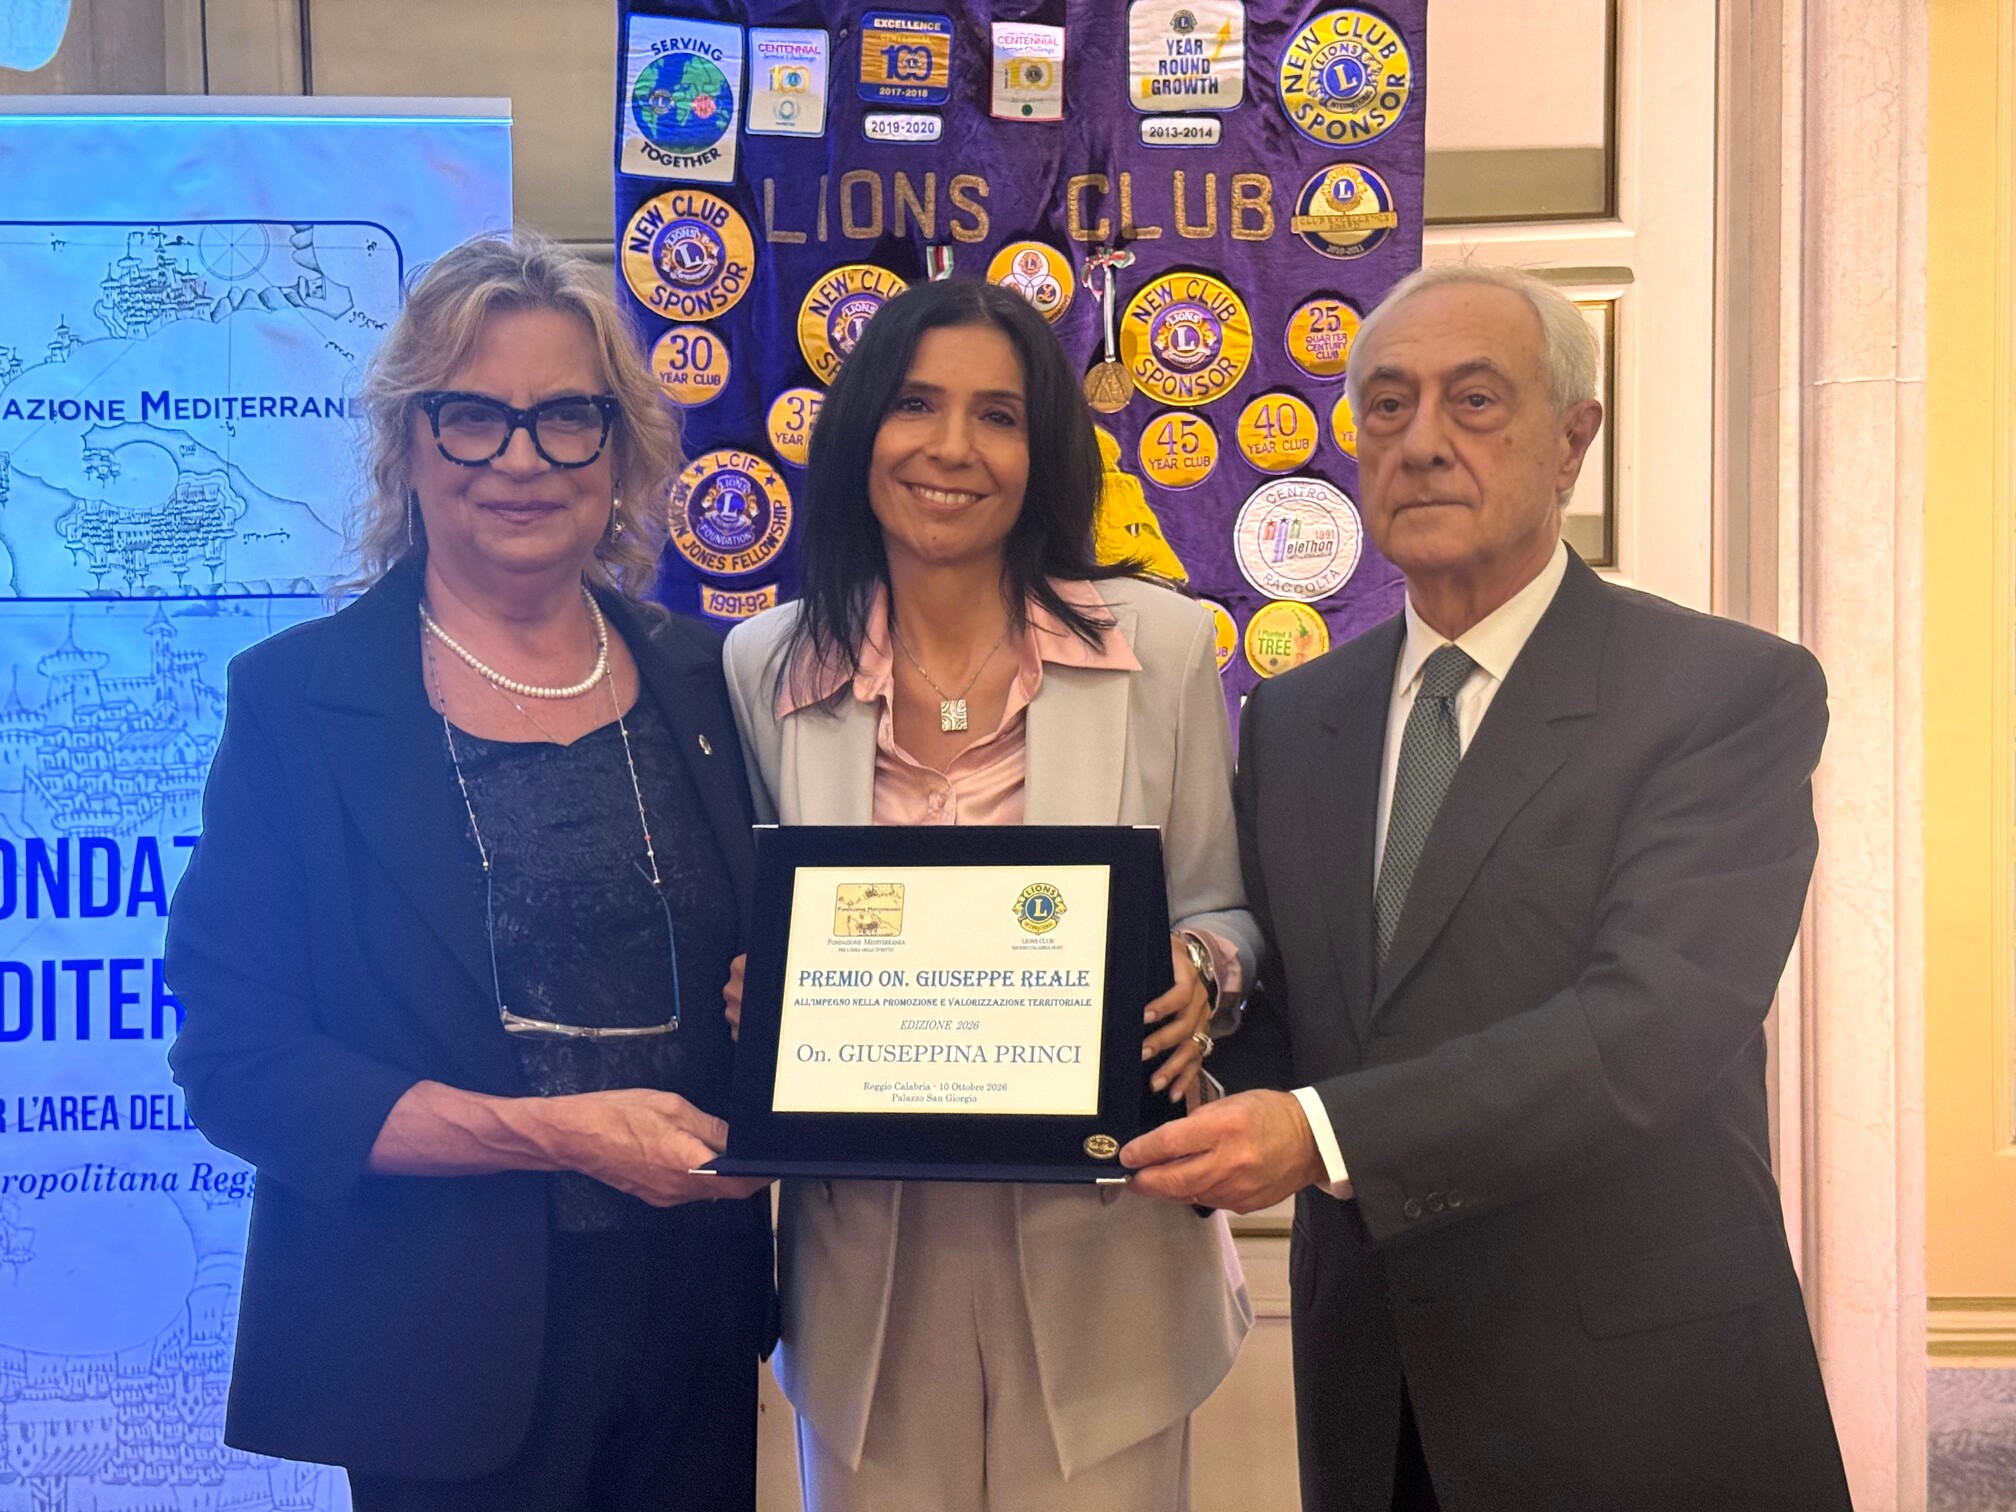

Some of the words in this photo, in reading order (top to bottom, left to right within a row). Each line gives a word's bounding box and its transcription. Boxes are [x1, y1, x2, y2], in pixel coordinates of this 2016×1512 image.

[874, 18, 941, 31] EXCELLENCE
[651, 37, 723, 61] SERVING
[758, 44, 821, 54] CENTENNIAL
[997, 36, 1059, 46] CENTENNIAL
[1166, 38, 1203, 56] YEAR
[880, 45, 933, 81] 100
[1284, 27, 1321, 94] NEW
[1332, 16, 1398, 59] CLUB
[1316, 43, 1359, 65] LIONS
[1158, 58, 1210, 76] ROUND
[1151, 77, 1218, 95] GROWTH
[1333, 64, 1358, 91] L
[879, 87, 928, 97] 2017-2018
[1294, 74, 1406, 140] SPONSOR
[871, 121, 934, 133] 2019-2020
[1149, 127, 1212, 138] 2013-2014
[640, 141, 722, 168] TOGETHER
[763, 170, 990, 244] LIONS
[1067, 170, 1276, 242] CLUB
[629, 205, 665, 254] NEW
[672, 195, 730, 228] CLUB
[669, 228, 697, 246] LIONS
[677, 244, 702, 268] L
[649, 262, 747, 316] SPONSOR
[809, 273, 850, 318] NEW
[861, 270, 902, 300] CLU
[1132, 281, 1174, 324] NEW
[1186, 280, 1237, 323] CLUB
[1167, 312, 1200, 325] LIONS
[1309, 306, 1342, 332] 25
[1176, 327, 1195, 351] L
[1306, 333, 1347, 344] QUARTER
[1306, 342, 1346, 352] CENTURY
[669, 334, 712, 371] 30
[1316, 351, 1339, 360] CLUB
[660, 372, 688, 384] YEAR
[693, 374, 721, 386] CLUB
[1135, 356, 1238, 397] SPONSOR
[2, 398, 125, 421] AZIONE
[1254, 403, 1297, 439] 40
[775, 432, 804, 446] YEAR
[1157, 420, 1199, 455] 45
[1340, 431, 1354, 442] YE
[1246, 442, 1277, 455] YEAR
[1282, 439, 1310, 451] CLUB
[715, 453, 759, 470] LCIF
[1148, 458, 1177, 471] YEAR
[1184, 456, 1211, 467] CLUB
[718, 479, 750, 494] LIONS
[1266, 486, 1327, 505] CENTRO
[721, 492, 738, 517] L
[682, 540, 726, 571] JONES
[732, 499, 787, 571] FELLOWSHIP
[700, 526, 751, 545] FOUNDATION
[1315, 530, 1335, 540] 1991
[1263, 569, 1341, 594] RACCOLTA
[709, 592, 770, 614] 1991-92
[1258, 638, 1291, 656] TREE
[1025, 885, 1056, 896] LIONS
[799, 970, 873, 988] PREMIO
[878, 970, 909, 988] ON.
[916, 970, 1015, 988] GIUSEPPE
[1020, 970, 1090, 988] REALE
[794, 998, 851, 1007] ALL'IMPEGNO
[852, 998, 880, 1006] NELLA
[883, 998, 938, 1006] PROMOZIONE
[940, 998, 946, 1006] E
[948, 997, 1026, 1007] VALORIZZAZIONE
[1027, 998, 1092, 1007] TERRITORIALE
[900, 1020, 953, 1030] EDIZIONE
[956, 1020, 980, 1030] 2026
[797, 1044, 831, 1062] On.
[838, 1044, 988, 1063] GIUSEPPINA
[994, 1045, 1082, 1063] PRINCI
[863, 1082, 892, 1092] Reggio
[894, 1081, 931, 1091] Calabria
[939, 1083, 949, 1091] 10
[951, 1082, 984, 1091] Ottobre
[986, 1083, 1008, 1091] 2026
[892, 1093, 924, 1102] Palazzo
[926, 1094, 943, 1102] San
[945, 1093, 977, 1104] Giorgio
[18, 1095, 120, 1133] L'AREA
